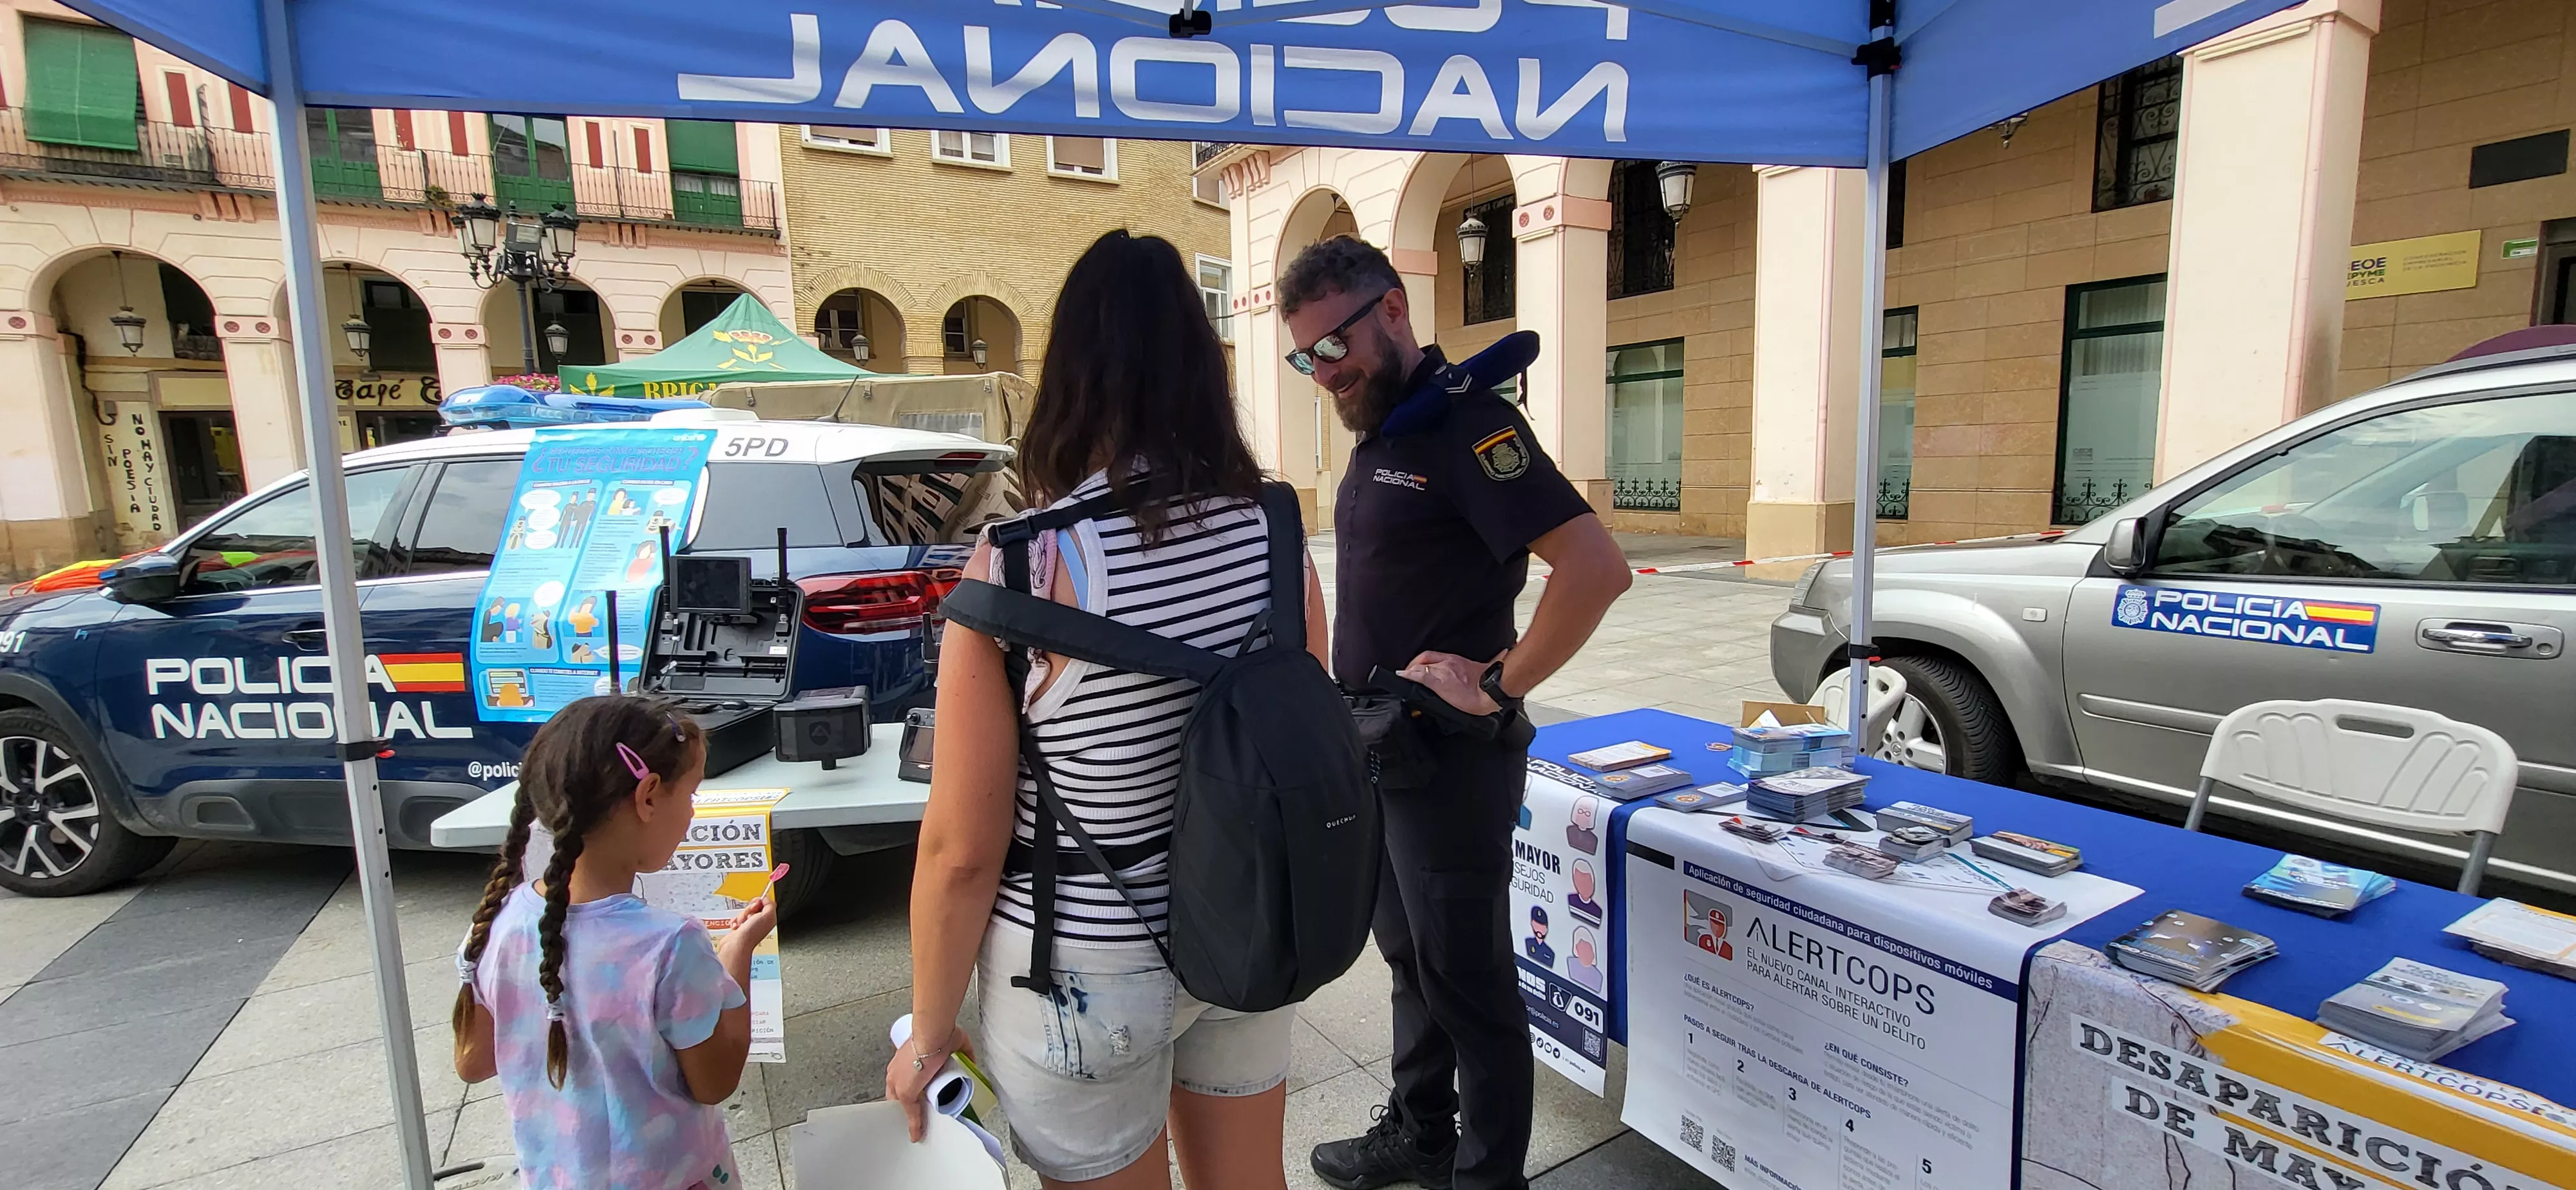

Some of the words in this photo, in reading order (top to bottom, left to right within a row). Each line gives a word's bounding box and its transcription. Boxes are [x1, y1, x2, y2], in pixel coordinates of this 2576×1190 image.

[2348, 256, 2387, 271] EOE
[131, 413, 146, 435] NO
[104, 434, 118, 467] SIN
[140, 439, 154, 473] HAY
[725, 438, 789, 457] 5PD
[122, 449, 141, 513] POESIA
[1372, 475, 1425, 491] NACIONAL
[1375, 468, 1414, 481] POLICIA
[144, 477, 162, 531] CIUDAD
[0, 631, 26, 653] 91
[2150, 611, 2370, 652] NACIONAL
[146, 654, 398, 695] POLICA
[468, 761, 523, 781] @polic
[1515, 839, 1561, 876] MAYOR
[1511, 876, 1554, 903] GURIDAD
[1689, 865, 1732, 889] Aplicación
[1733, 882, 1744, 894] de
[1746, 887, 1791, 912] seguridad
[1793, 905, 1844, 932] ciudadana
[1847, 925, 1871, 943] para
[1873, 935, 1941, 970] dispositivos
[1944, 962, 1993, 990] móviles
[1746, 917, 1935, 1015] ALERTCOPS
[1683, 973, 1700, 986] ¿QUÉ
[1701, 980, 1710, 990] ES
[1711, 985, 1755, 1012] ALERTCOPS?
[1747, 946, 1758, 961] EL
[1761, 952, 1794, 976] NUEVO
[1797, 969, 1832, 994] CANAL
[1835, 985, 1911, 1028] INTERACTIVO
[1575, 1001, 1600, 1028] 091
[1747, 960, 1771, 980] PARA
[1773, 972, 1818, 1002] ALERTAR
[1821, 994, 1859, 1020] SOBRE
[1862, 1011, 1878, 1029] UN
[1882, 1021, 1926, 1050] DELITO
[1688, 1032, 1693, 1044] 1
[1683, 1014, 1705, 1030] PASOS
[1706, 1026, 1710, 1034] A
[1712, 1029, 1736, 1048] SEGUIR
[1738, 1042, 1756, 1058] TRAS
[1757, 1053, 1767, 1064] LA
[1768, 1059, 1809, 1087] DESCARGA
[1811, 1081, 1822, 1093] DE
[1823, 1088, 1871, 1119] ALERTCOPS
[1737, 1059, 1745, 1073] 2
[1824, 1042, 1840, 1055] ¿EN
[1842, 1048, 1859, 1063] QUÉ
[1861, 1058, 1909, 1088] CONSISTE?
[1788, 1087, 1797, 1101] 3
[2080, 1021, 2521, 1190] DESAPARICIÓ
[1845, 1119, 1855, 1133] 4
[2125, 1085, 2195, 1139] DE
[2223, 1126, 2365, 1190] MAY
[1744, 1153, 1759, 1167] MÁS
[1922, 1158, 1932, 1175] 5
